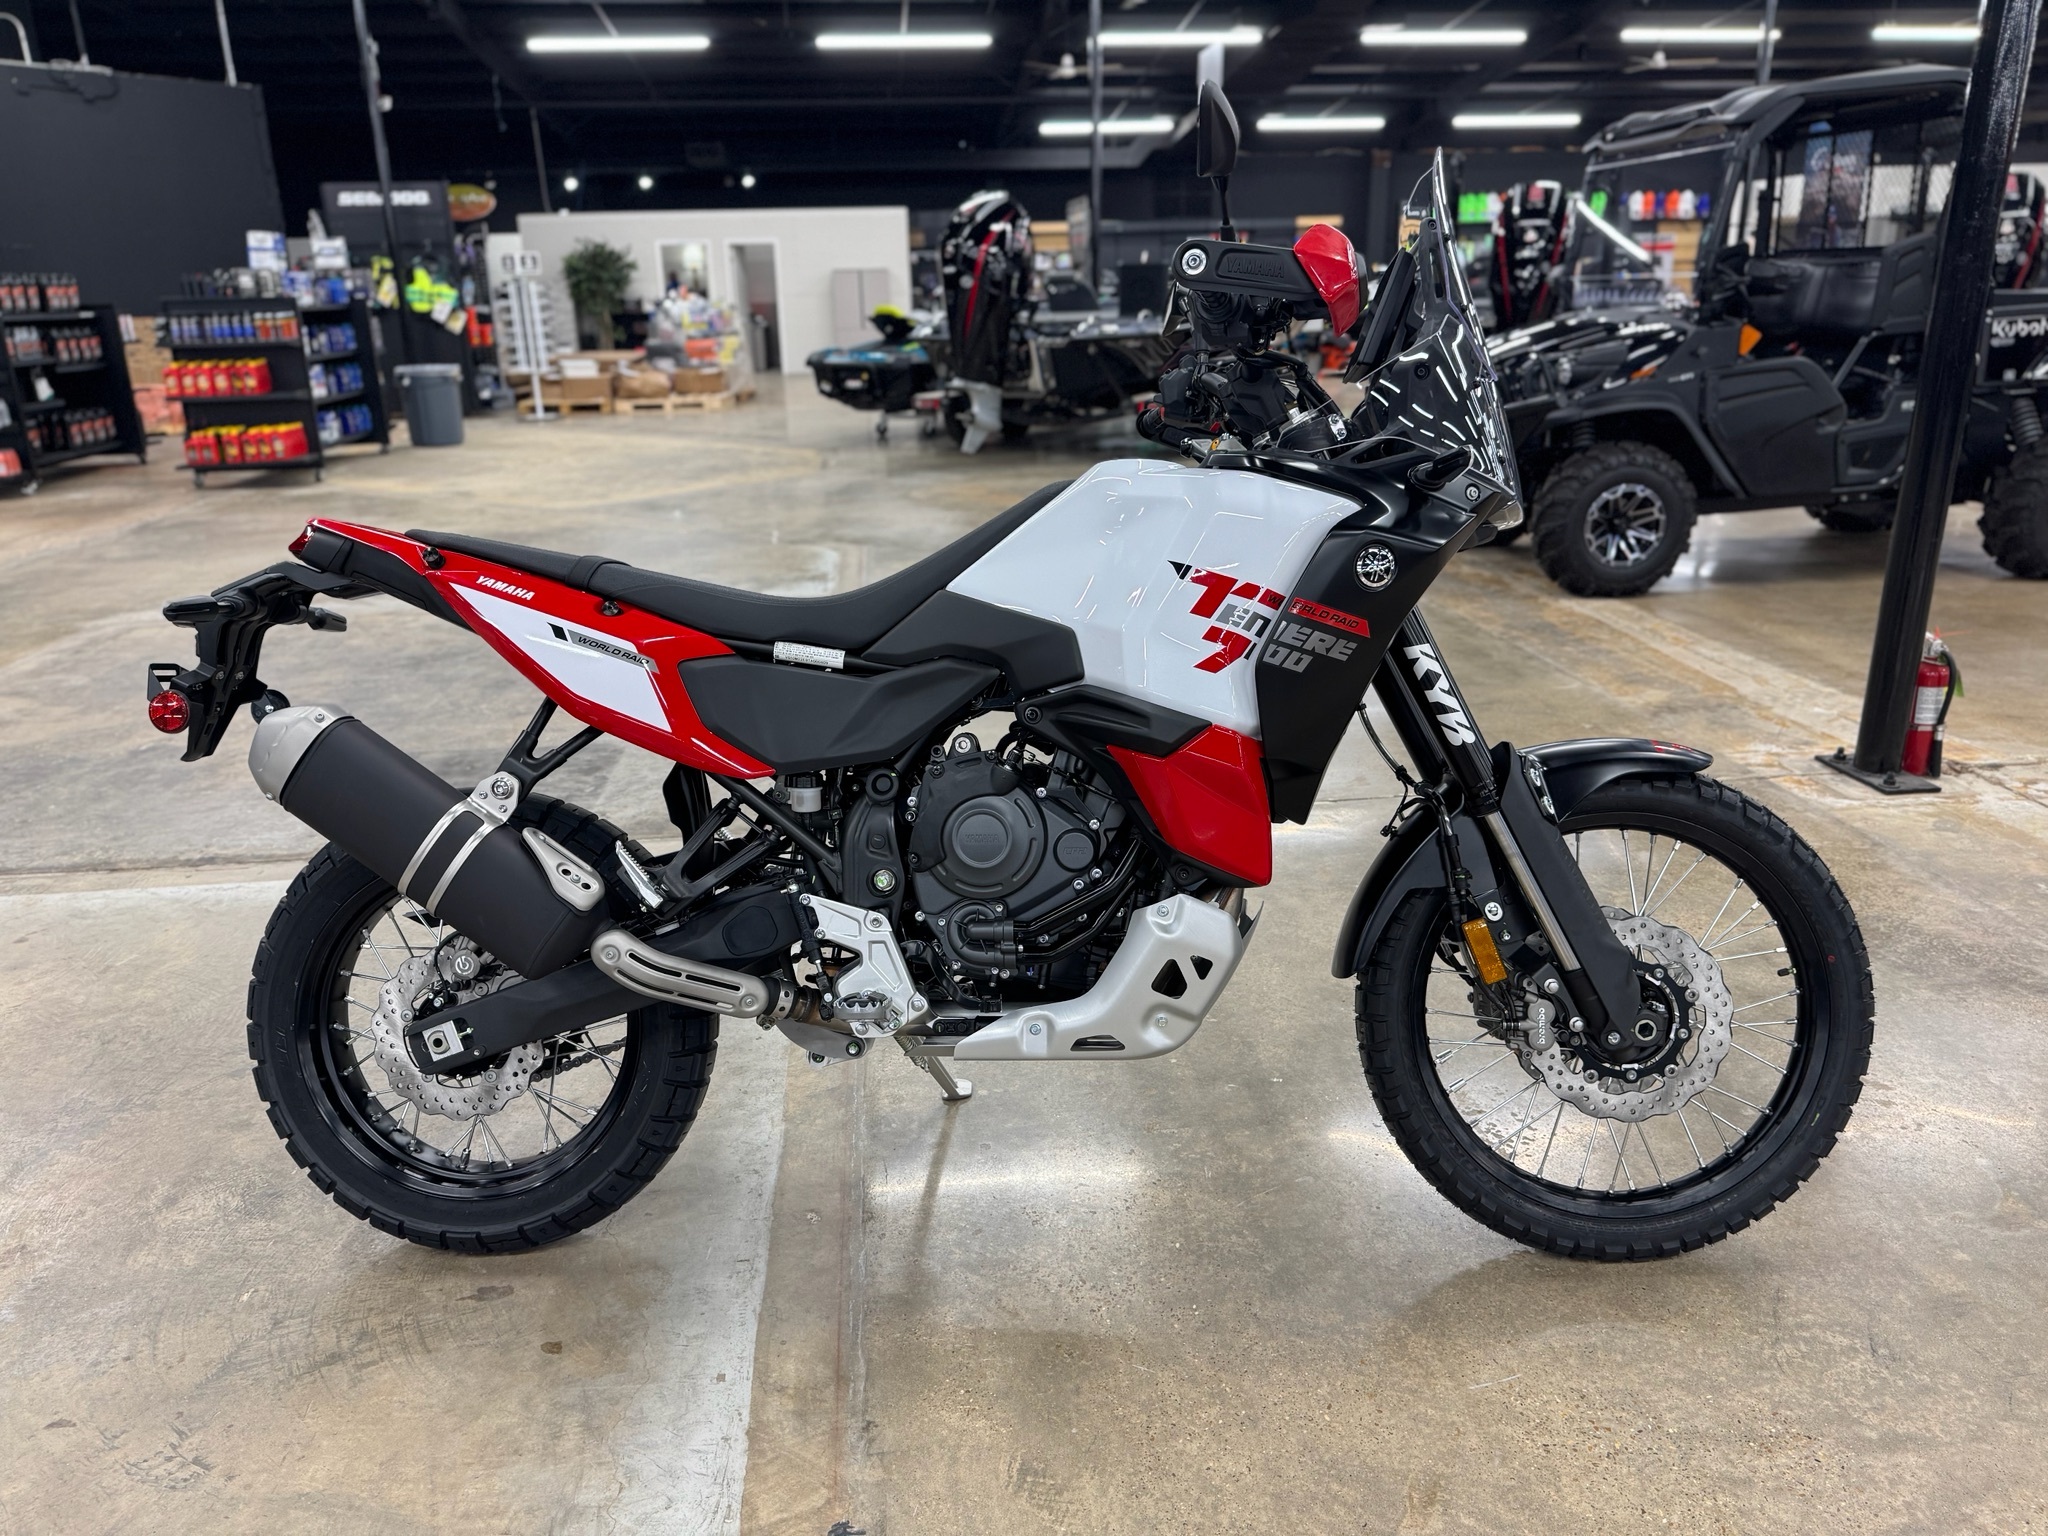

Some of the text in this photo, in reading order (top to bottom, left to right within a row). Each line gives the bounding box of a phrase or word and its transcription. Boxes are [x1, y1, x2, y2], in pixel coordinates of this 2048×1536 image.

[1227, 257, 1284, 278] YAMAHA
[1991, 316, 2048, 338] Kubot
[476, 576, 535, 600] YAMAHA
[1329, 612, 1360, 629] RAID
[578, 636, 650, 665] WORLD RAID
[1403, 643, 1475, 746] KYB
[1537, 1007, 1545, 1044] brembo
